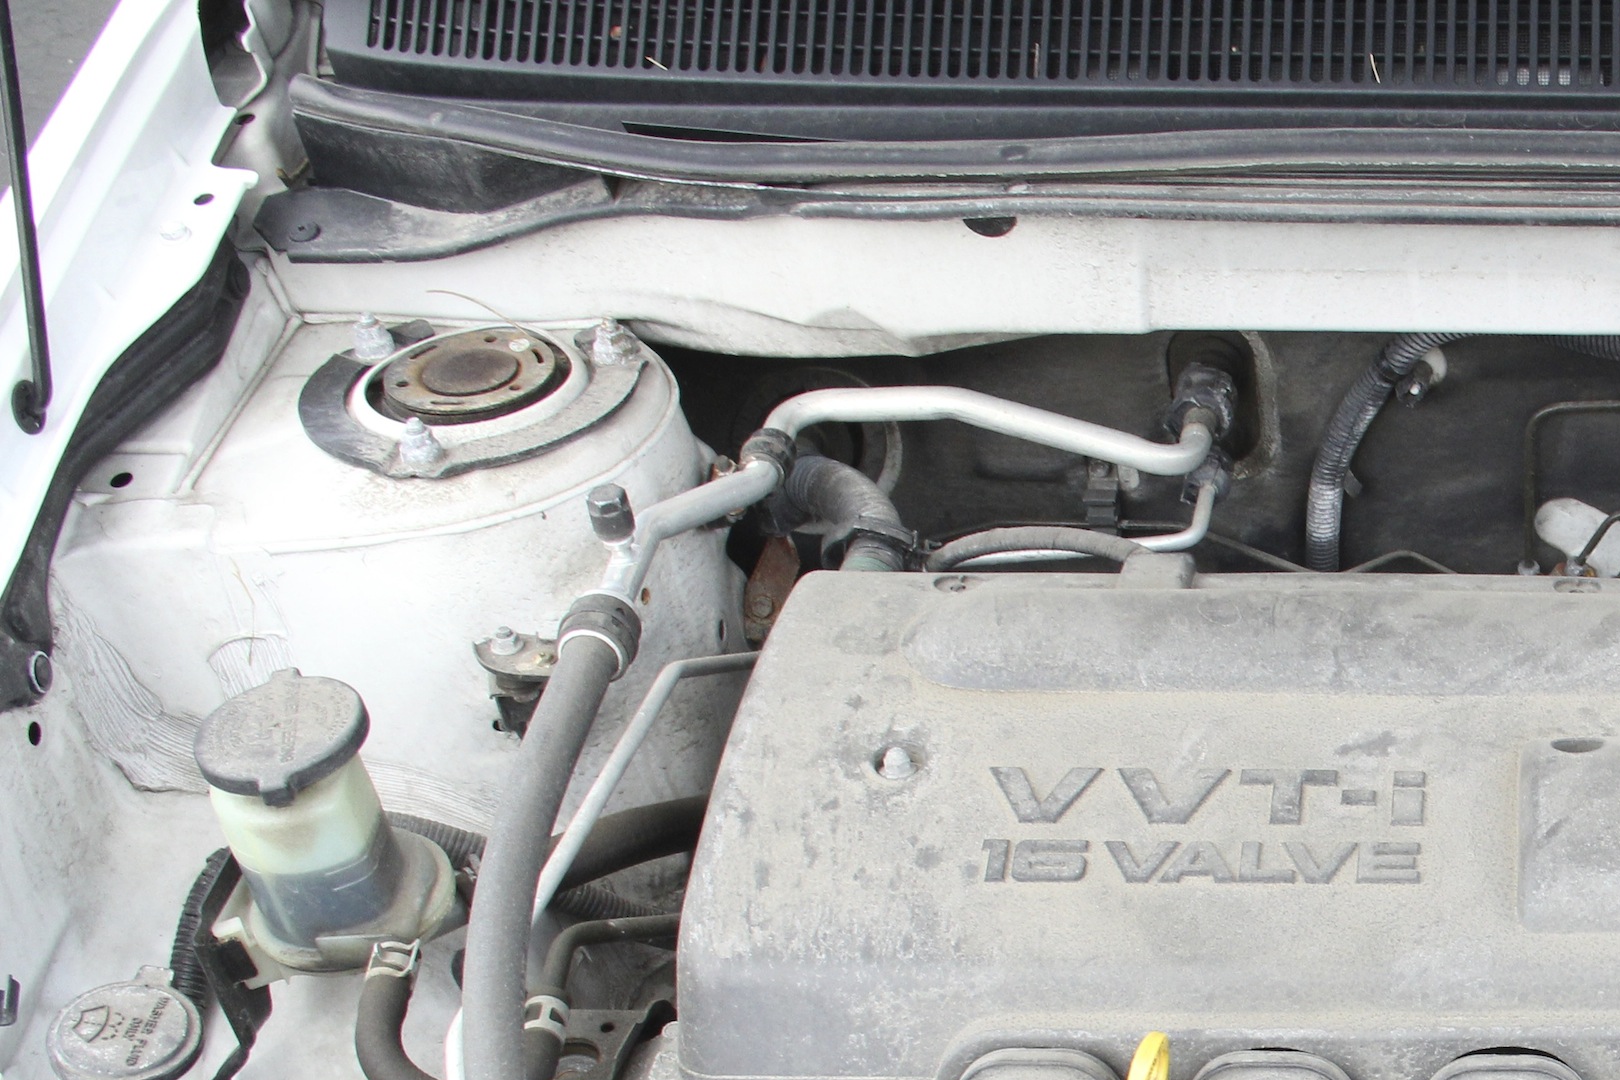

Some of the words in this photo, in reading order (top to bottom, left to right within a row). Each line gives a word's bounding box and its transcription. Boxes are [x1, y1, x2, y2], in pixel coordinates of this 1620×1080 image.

[989, 766, 1426, 826] VVT-i
[982, 838, 1089, 884] 16
[1104, 840, 1421, 884] VALVE
[140, 996, 171, 1036] WASHER
[126, 1038, 148, 1067] FLUID
